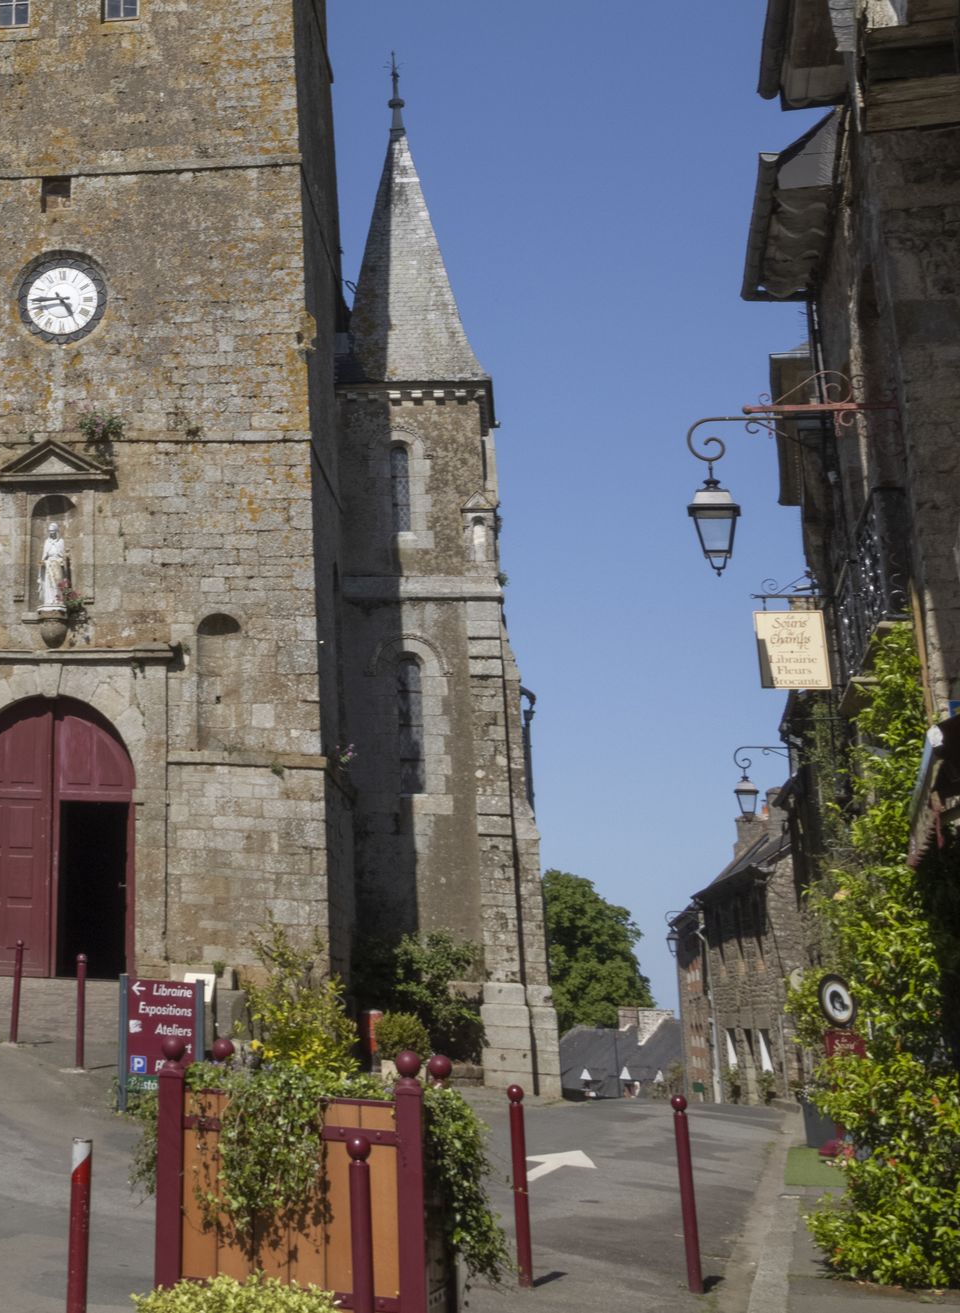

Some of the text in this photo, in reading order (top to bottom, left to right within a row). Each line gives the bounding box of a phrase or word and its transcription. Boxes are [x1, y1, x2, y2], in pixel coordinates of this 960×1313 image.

[771, 617, 807, 628] Souris
[769, 654, 817, 663] Librairie
[777, 665, 812, 674] Fleurs
[772, 676, 821, 685] Brocante
[153, 984, 193, 997] Librairie
[138, 1001, 192, 1016] Expositions
[154, 1023, 192, 1036] Ateliers
